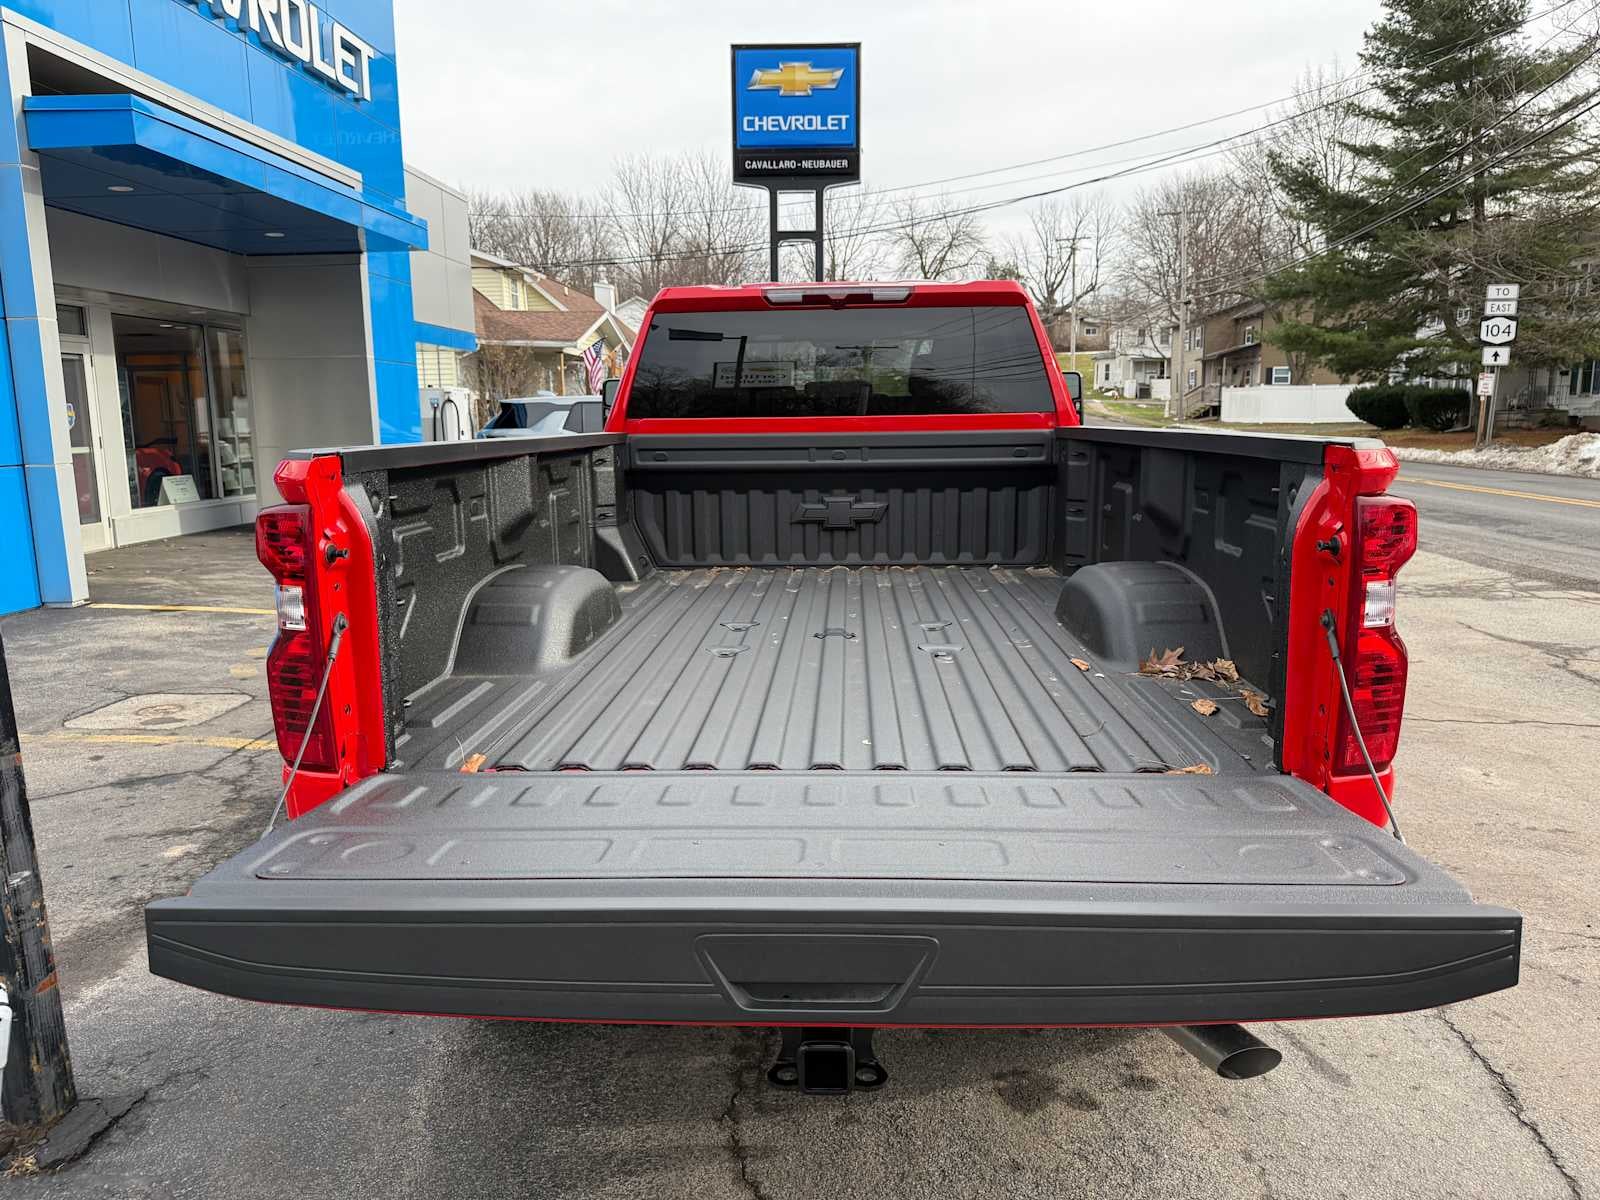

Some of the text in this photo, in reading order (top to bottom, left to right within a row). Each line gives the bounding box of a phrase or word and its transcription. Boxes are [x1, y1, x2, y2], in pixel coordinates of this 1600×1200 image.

[743, 115, 850, 131] CHEVROLET
[1495, 287, 1511, 297] TO
[1490, 303, 1512, 313] EAST
[1485, 323, 1512, 338] 104
